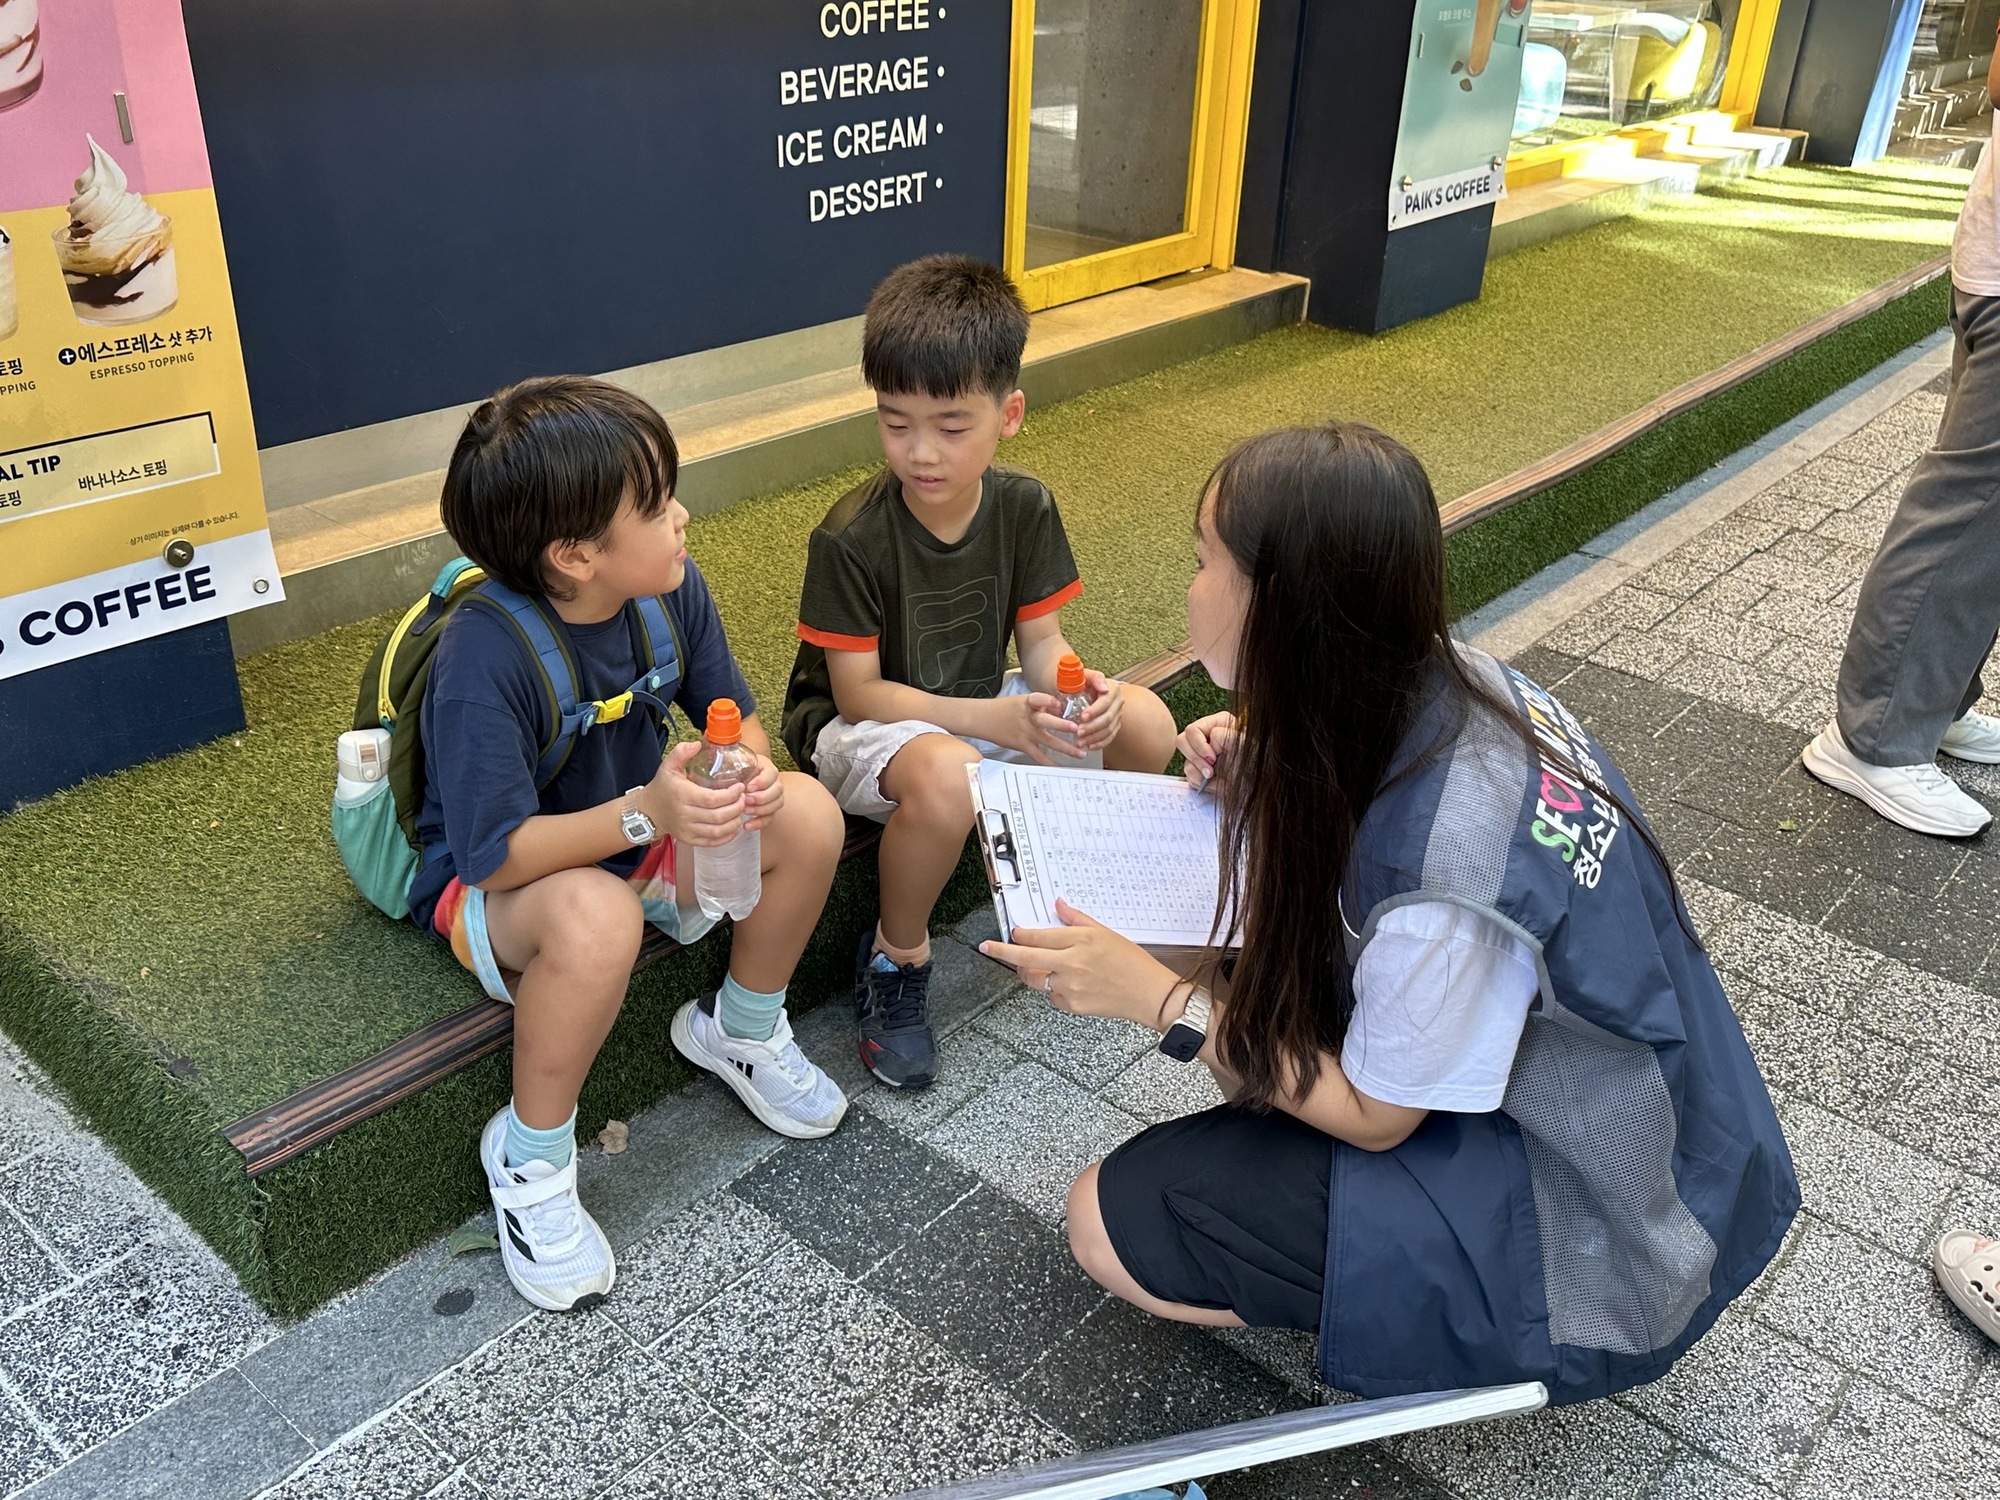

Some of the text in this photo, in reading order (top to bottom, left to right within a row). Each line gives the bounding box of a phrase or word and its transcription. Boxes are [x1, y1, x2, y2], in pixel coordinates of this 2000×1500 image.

[820, 0, 930, 38] COFFEE
[780, 56, 929, 105] BEVERAGE
[777, 114, 927, 168] ICE CREAM
[809, 171, 928, 223] DESSERT
[1405, 175, 1490, 215] PAIK'S COFFEE
[78, 326, 212, 363] 에스프레소 샷 추가
[90, 352, 195, 380] ESPRESSO TOPPING
[26, 455, 61, 475] TIP
[78, 459, 167, 491] 바나나소스 토핑
[144, 530, 171, 541] 이미지는
[19, 565, 216, 646] COFFEE
